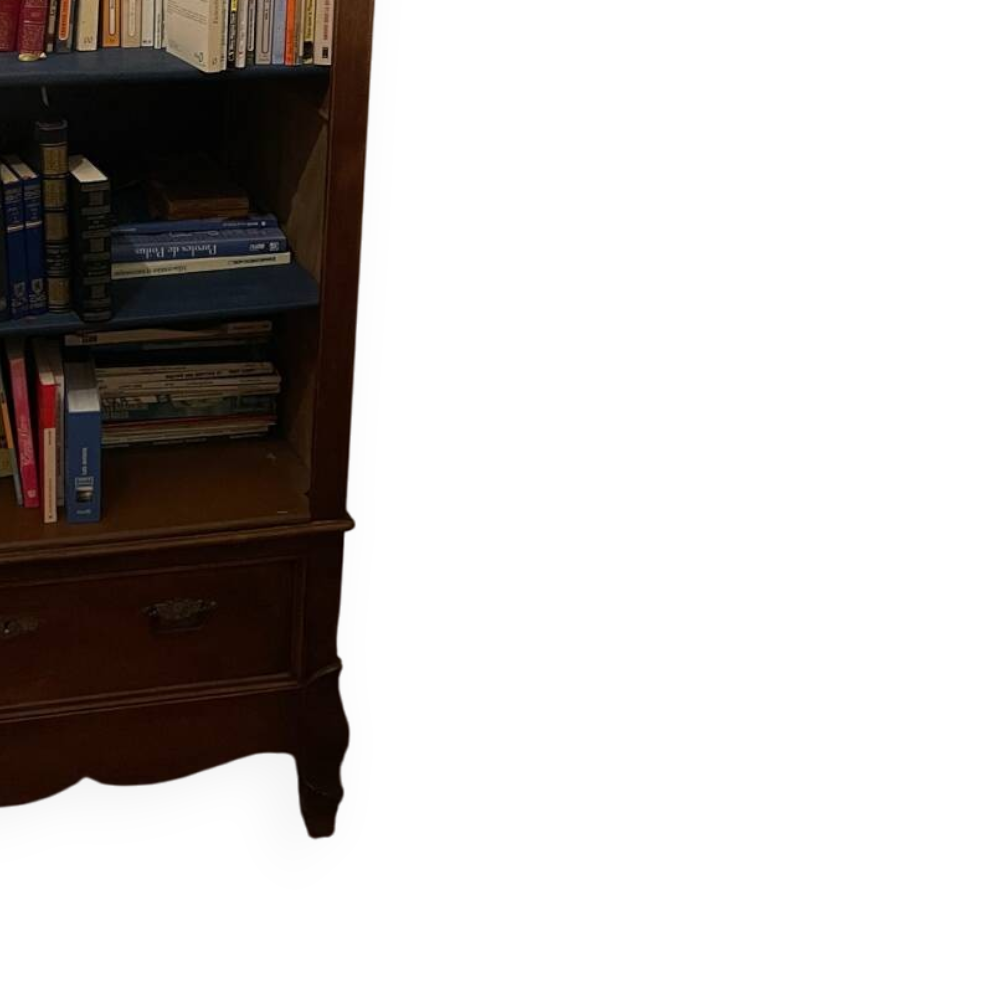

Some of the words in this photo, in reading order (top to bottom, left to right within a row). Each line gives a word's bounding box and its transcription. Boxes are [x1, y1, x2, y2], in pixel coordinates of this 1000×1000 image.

[134, 246, 165, 260] Poilus
[167, 246, 180, 257] de
[181, 242, 217, 257] Paroles
